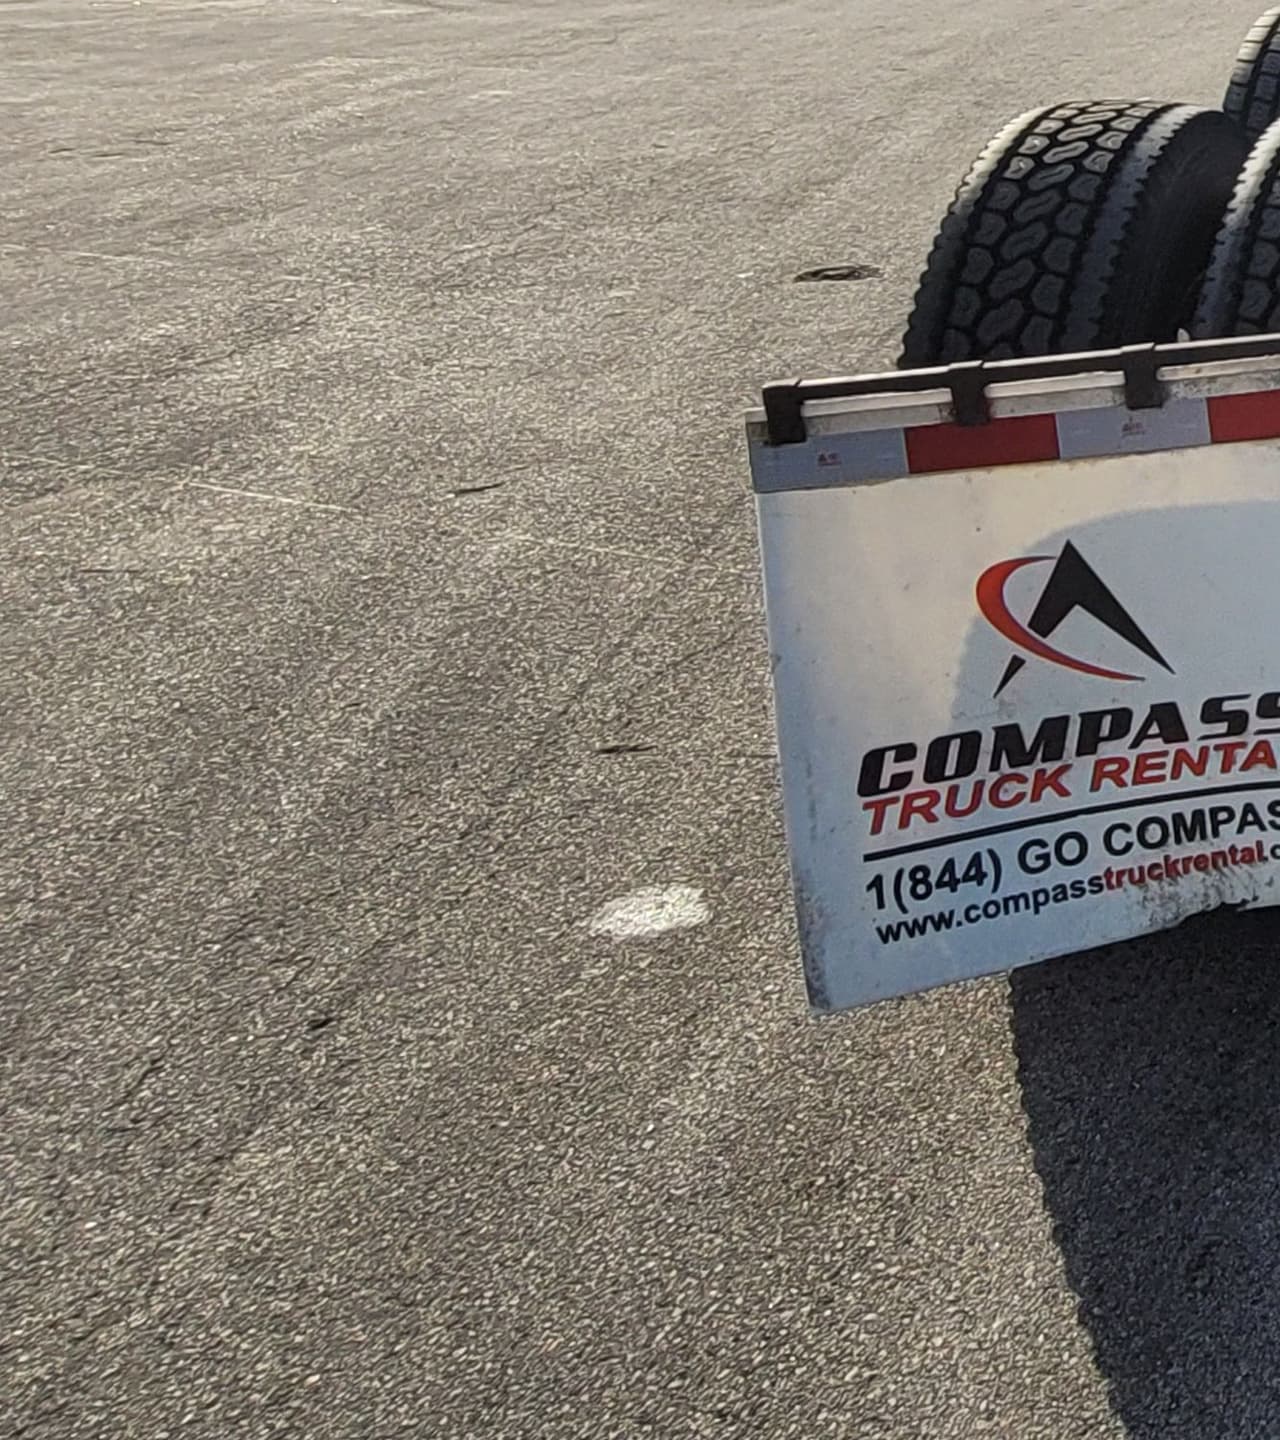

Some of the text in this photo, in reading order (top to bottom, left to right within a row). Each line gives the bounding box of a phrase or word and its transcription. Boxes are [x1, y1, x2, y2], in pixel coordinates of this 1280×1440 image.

[862, 763, 1073, 835] TRUCK
[866, 848, 1002, 914] 1(844)
[1017, 831, 1088, 874] GO
